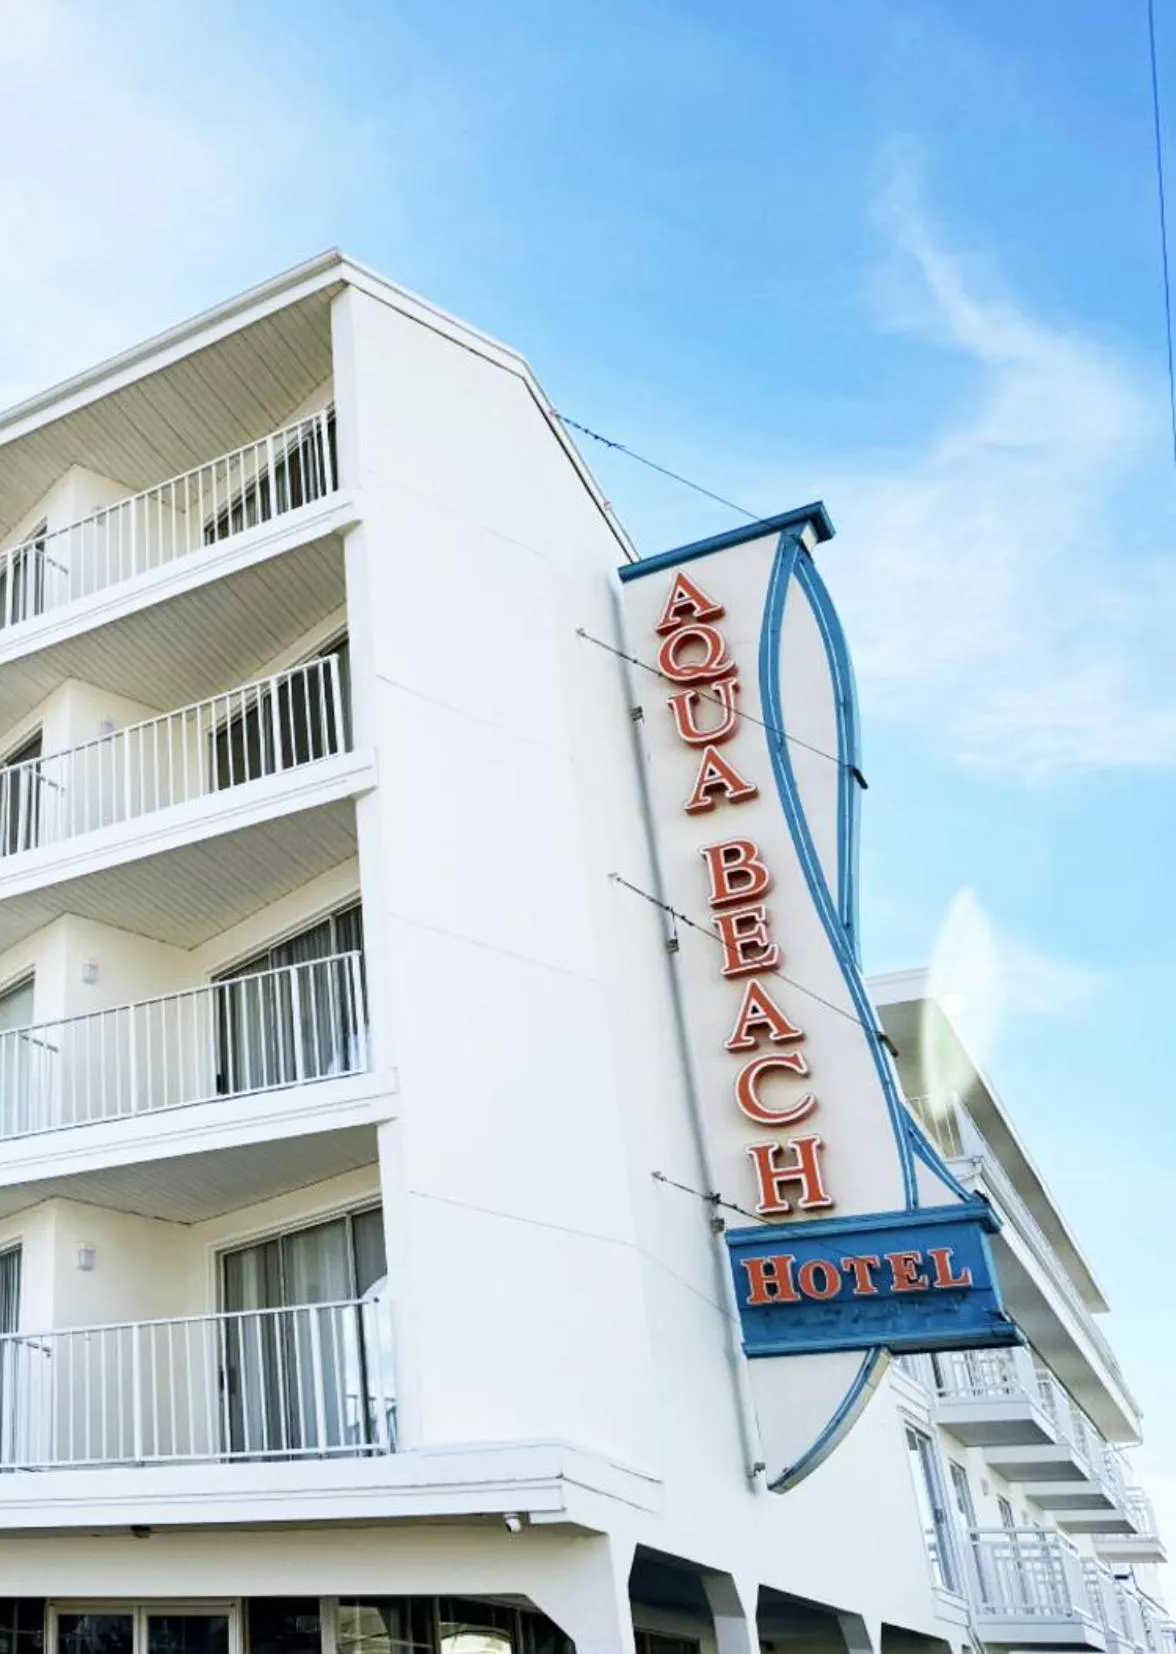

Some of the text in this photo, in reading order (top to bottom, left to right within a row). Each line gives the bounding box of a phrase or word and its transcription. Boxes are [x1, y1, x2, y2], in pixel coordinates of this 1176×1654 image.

[656, 570, 834, 1216] AQUA BEACH
[740, 1247, 973, 1304] HOTEL
